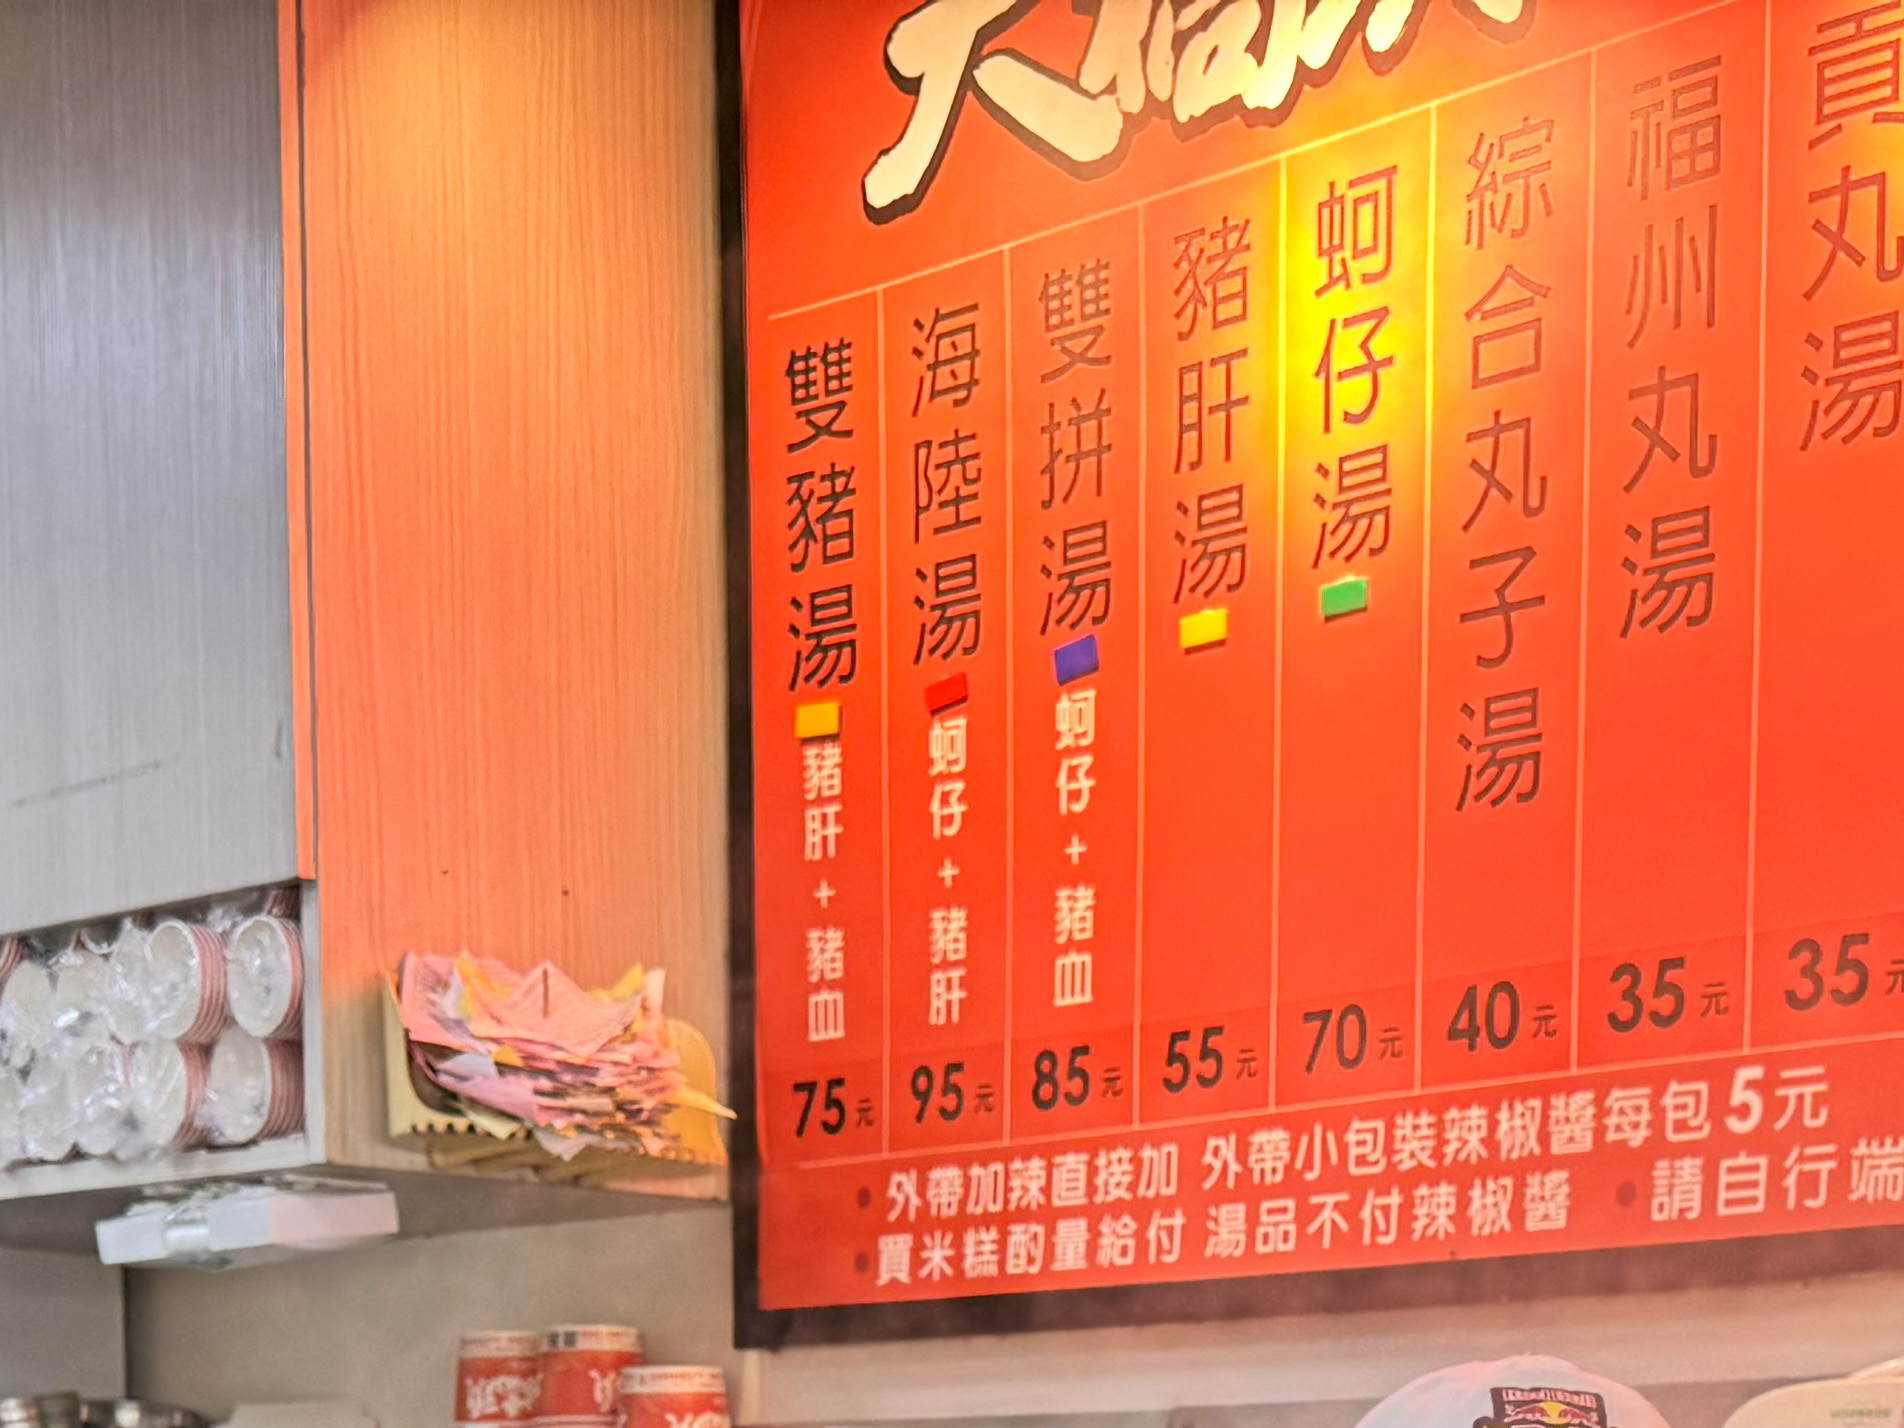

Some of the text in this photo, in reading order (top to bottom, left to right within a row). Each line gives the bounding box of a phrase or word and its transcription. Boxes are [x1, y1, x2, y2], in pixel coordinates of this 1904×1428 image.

[785, 337, 858, 693] 雙豬湯
[910, 301, 982, 668] 海陸湯
[1038, 259, 1113, 636] 雙拼湯
[1173, 214, 1252, 605] 豬肝湯
[1312, 165, 1399, 571] 蚵仔湯
[1454, 115, 1556, 812] 綜合丸子湯
[1618, 55, 1723, 639] 福州丸湯
